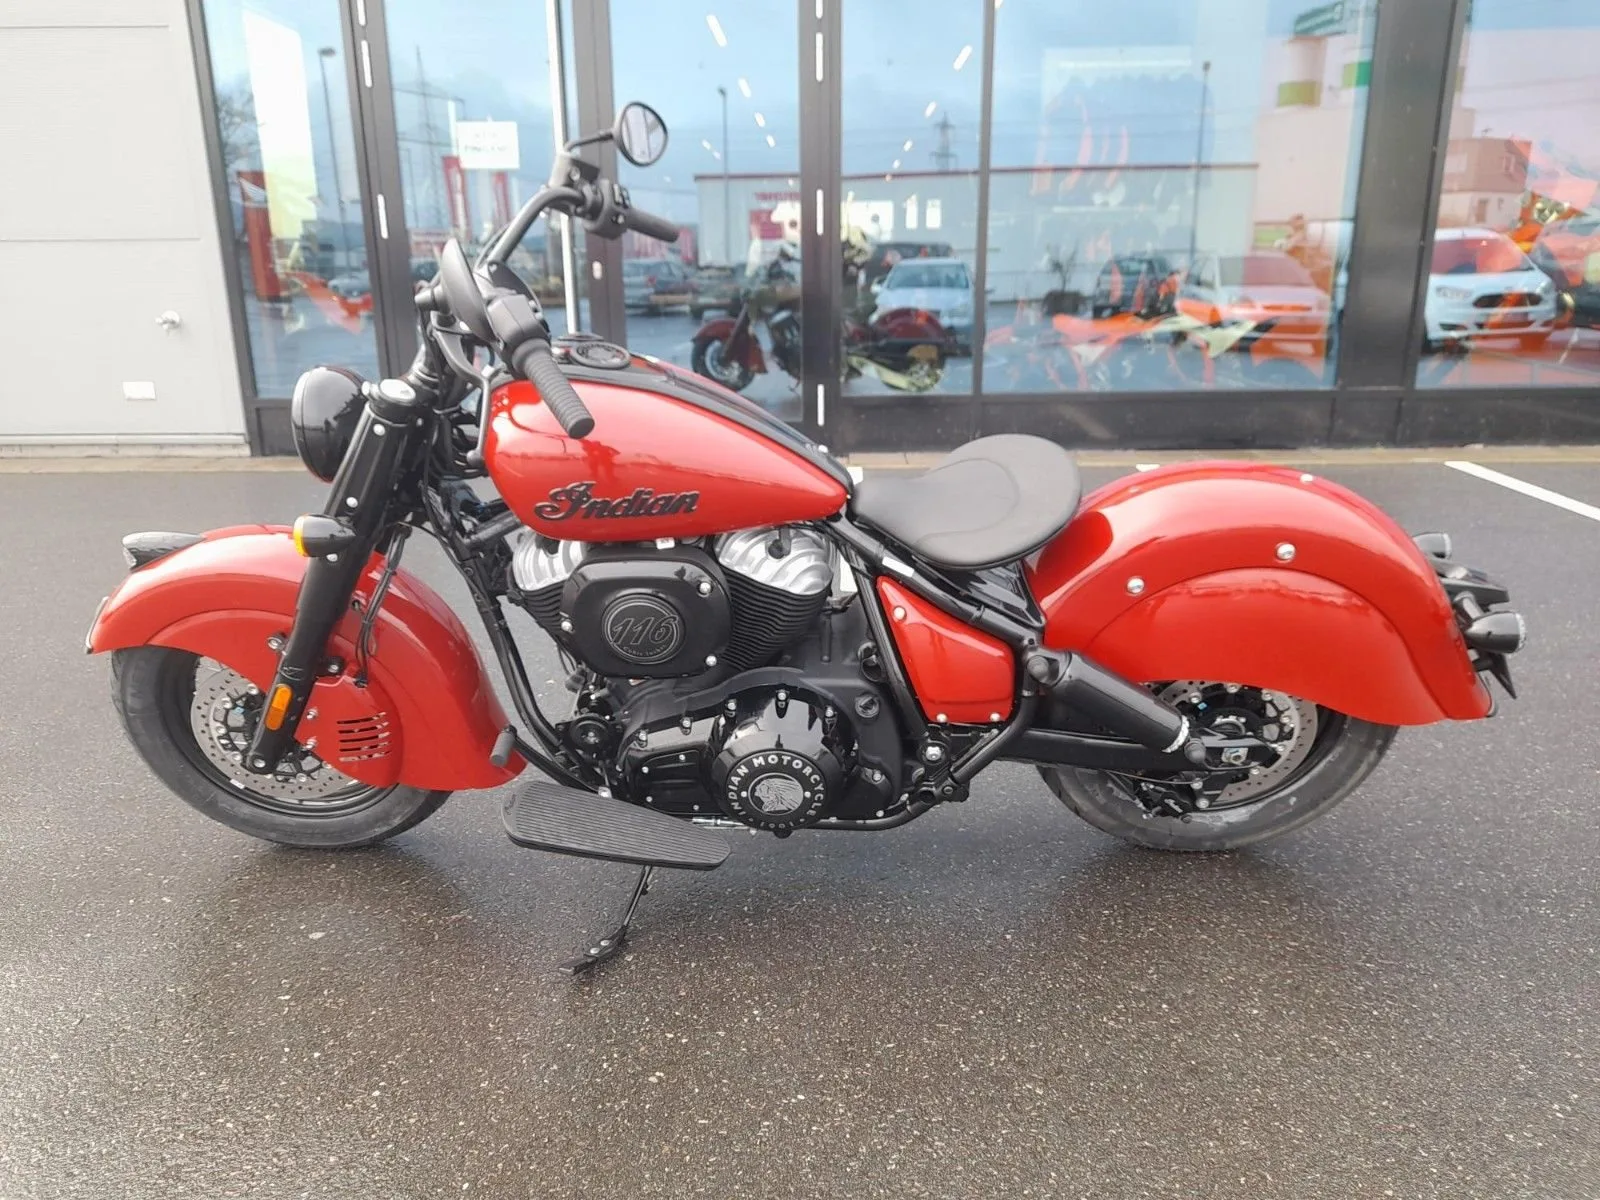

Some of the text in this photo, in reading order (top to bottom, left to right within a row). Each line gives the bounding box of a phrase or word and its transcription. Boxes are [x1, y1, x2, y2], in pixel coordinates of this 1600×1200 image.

[534, 480, 700, 521] Indian
[610, 614, 679, 645] 116
[728, 754, 824, 817] INDIAN MOTORCYCLE
